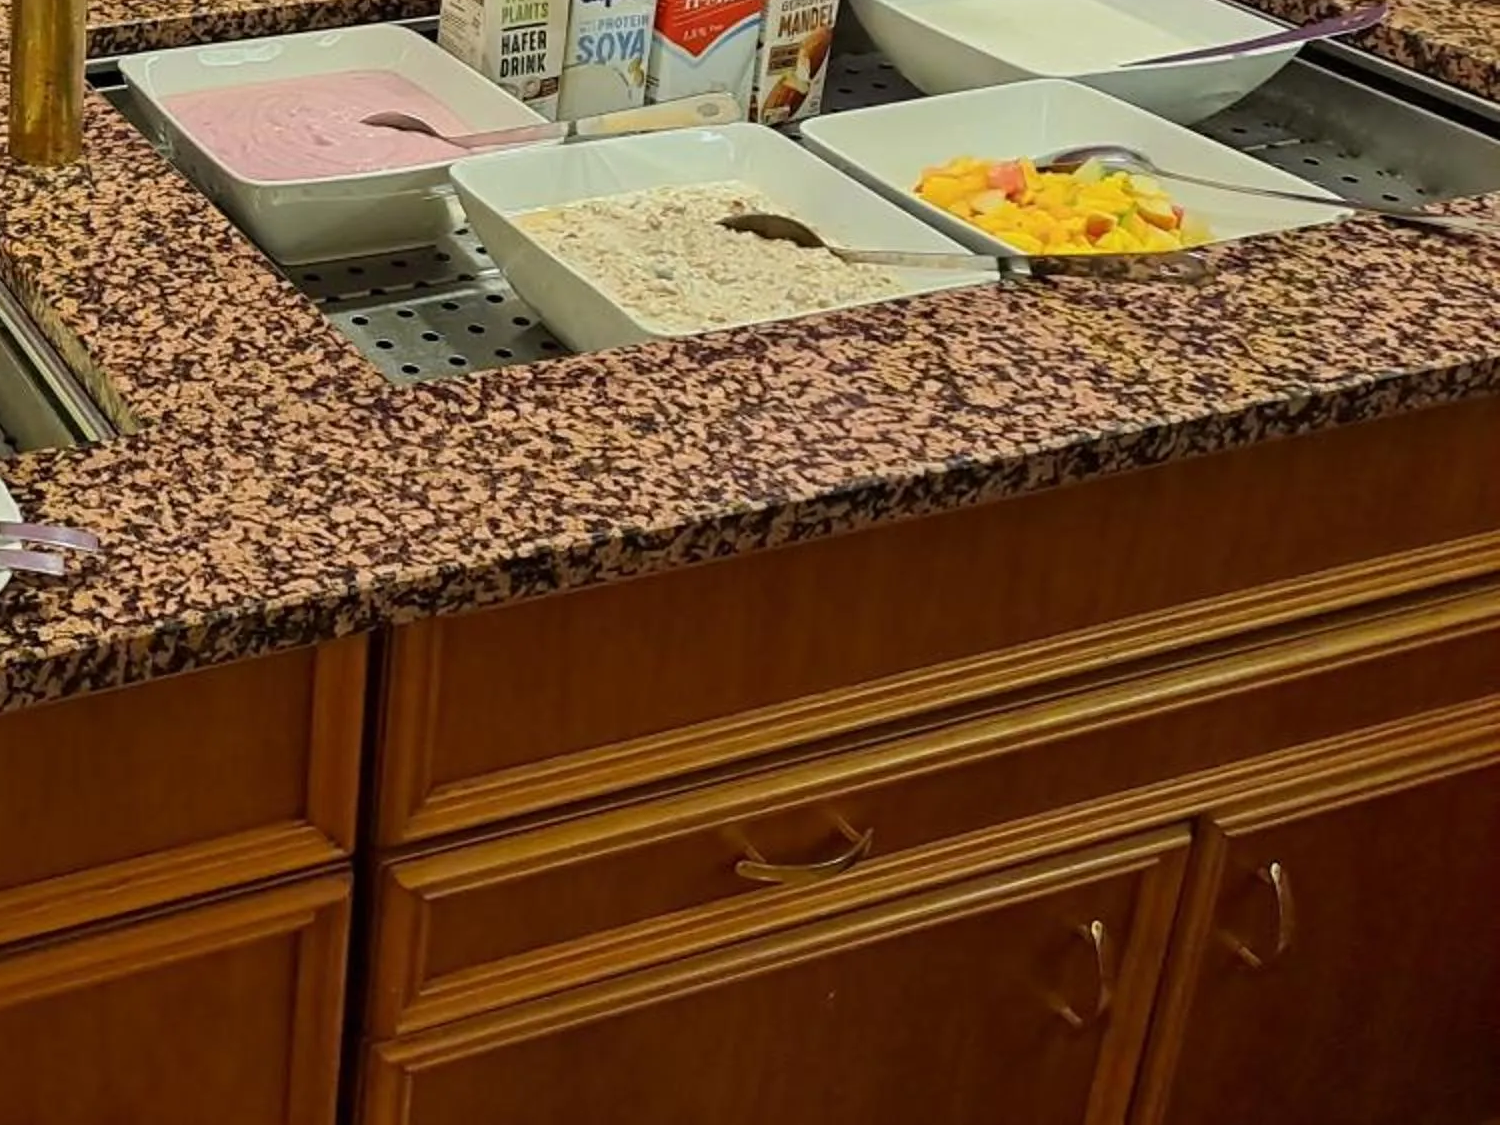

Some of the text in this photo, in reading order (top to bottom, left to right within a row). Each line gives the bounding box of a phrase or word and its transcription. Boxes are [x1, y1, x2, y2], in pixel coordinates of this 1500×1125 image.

[502, 2, 549, 24] PLANTS
[501, 30, 547, 55] HAFER
[576, 29, 645, 65] SOYA
[500, 53, 547, 77] DRINK
